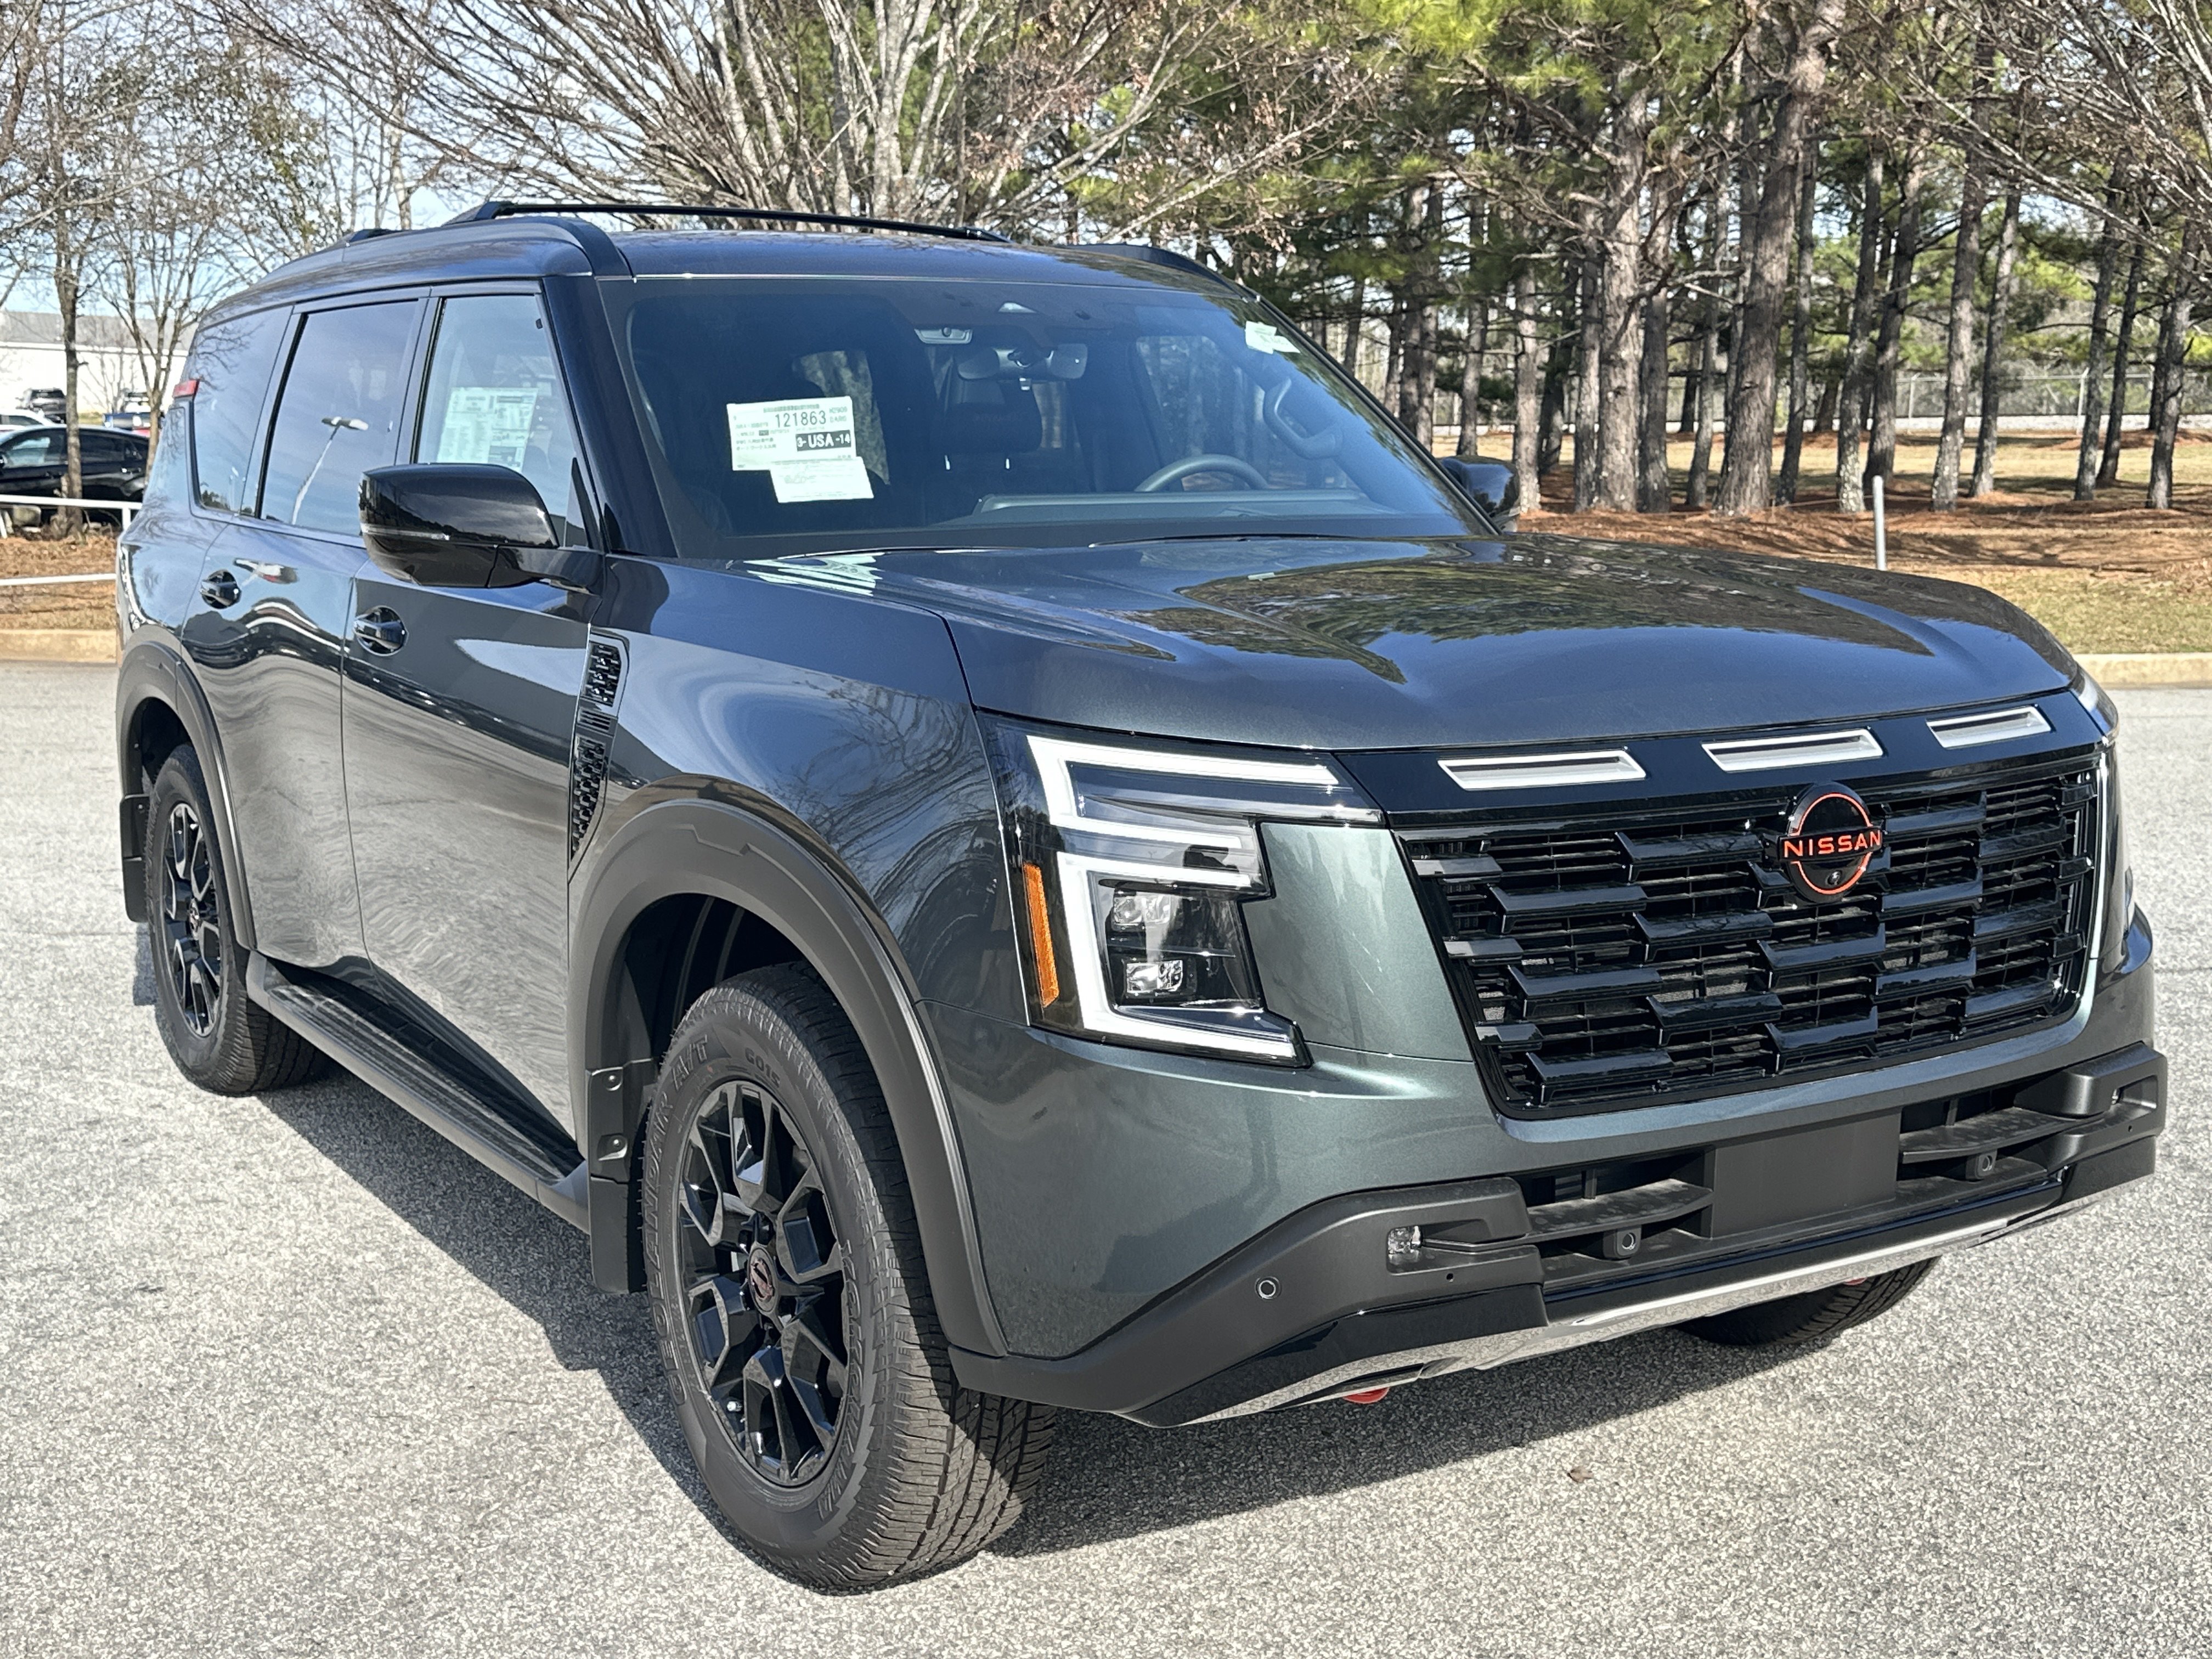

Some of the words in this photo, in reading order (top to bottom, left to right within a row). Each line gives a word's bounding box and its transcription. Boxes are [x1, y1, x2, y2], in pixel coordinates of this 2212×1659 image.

[774, 410, 827, 428] 121863
[1784, 830, 1881, 858] NISSAN
[744, 1047, 781, 1089] G015
[643, 1091, 687, 1406] GEOLANDAR
[672, 1034, 708, 1092] A/T
